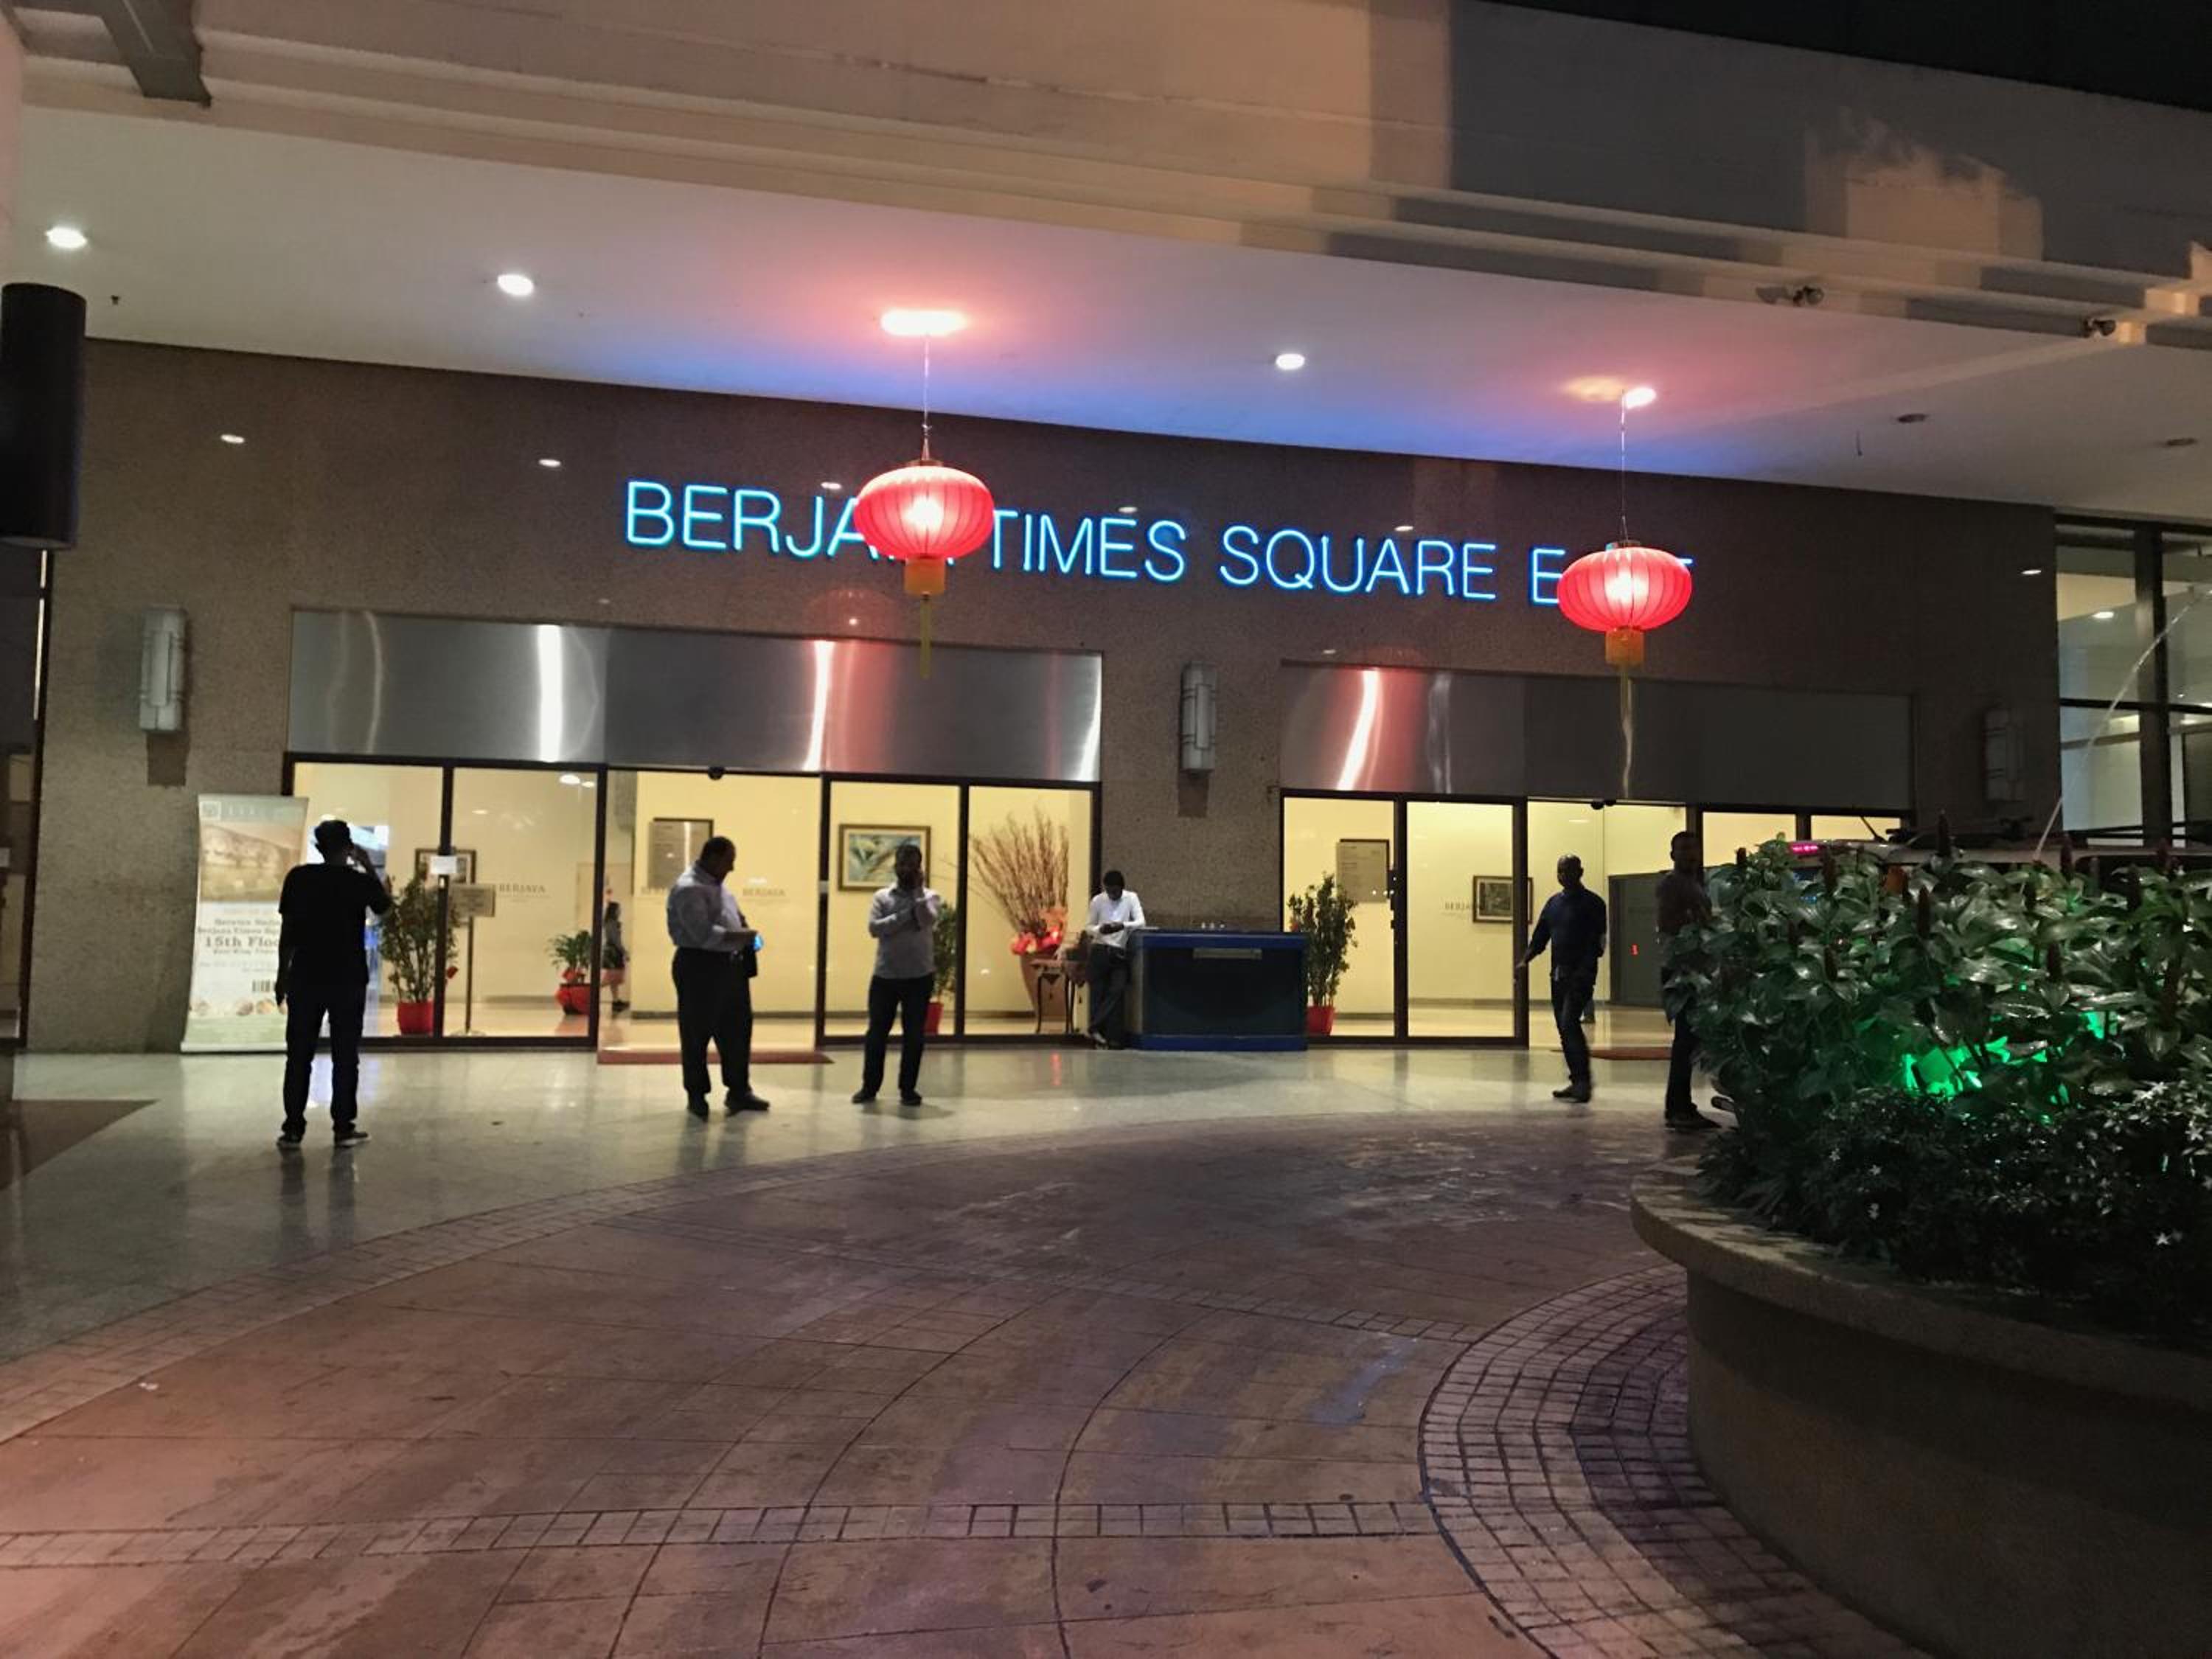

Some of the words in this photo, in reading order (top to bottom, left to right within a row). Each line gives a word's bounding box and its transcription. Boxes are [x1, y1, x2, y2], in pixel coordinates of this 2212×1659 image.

[626, 480, 956, 567] BERJA
[990, 509, 1186, 582] TIMES
[1219, 524, 1497, 600] SQUARE
[498, 883, 546, 894] BERJAYA
[207, 936, 242, 947] 15th
